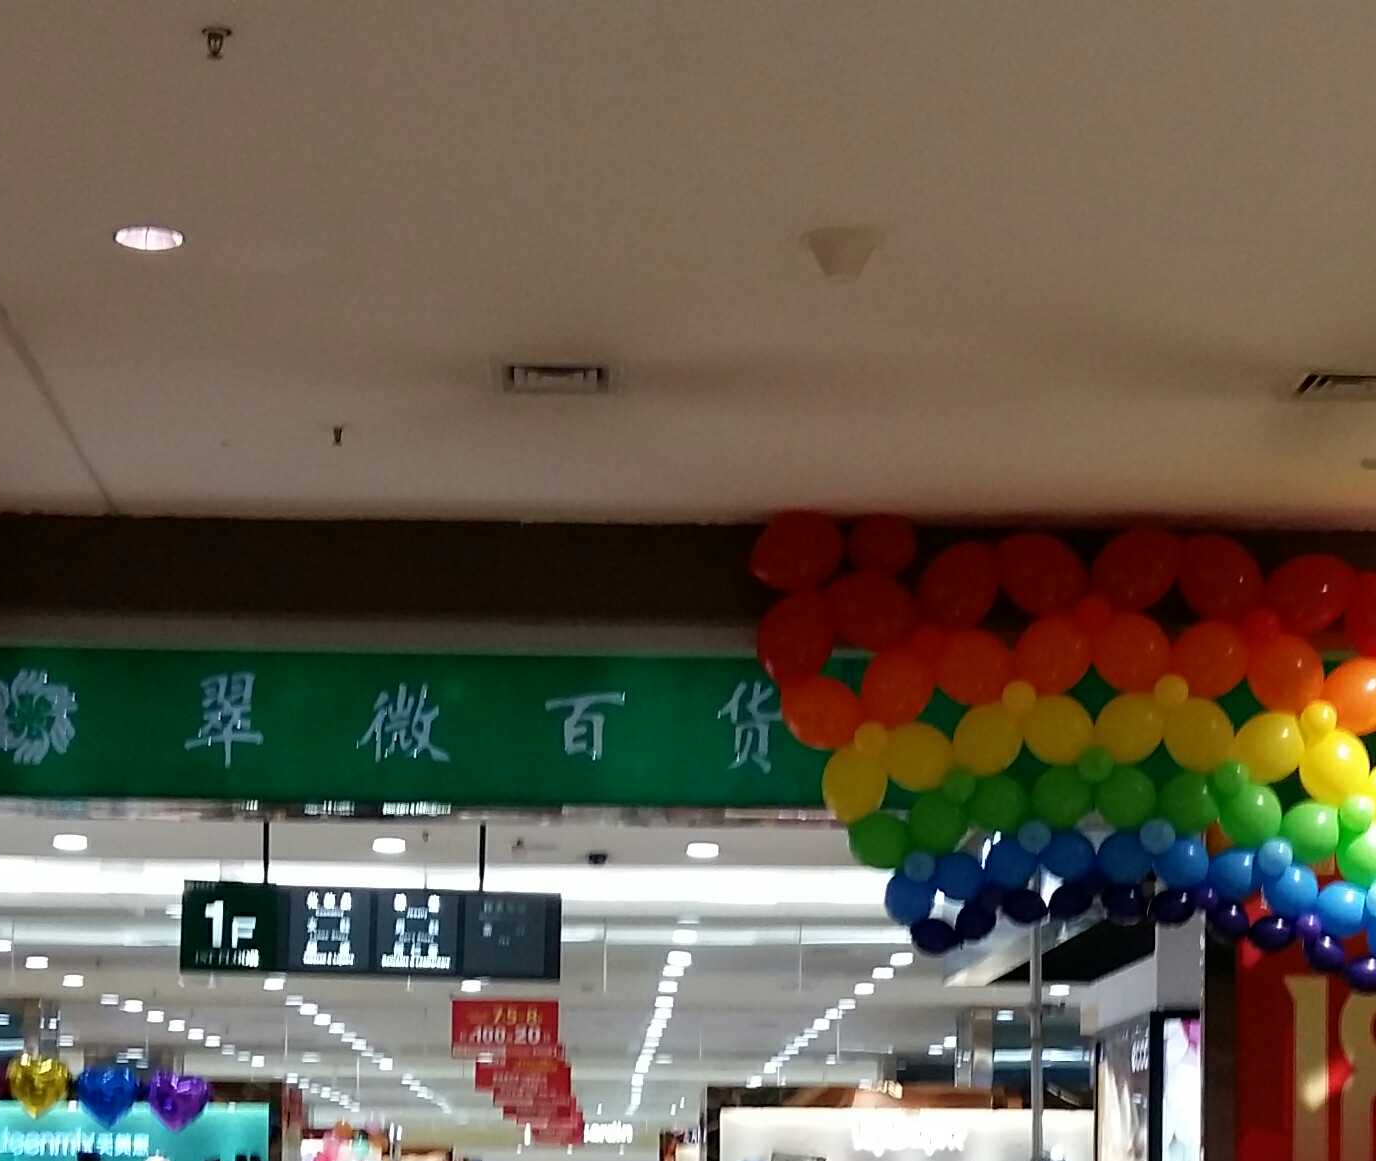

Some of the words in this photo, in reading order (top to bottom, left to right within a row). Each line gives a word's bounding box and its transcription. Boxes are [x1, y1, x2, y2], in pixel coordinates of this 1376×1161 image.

[183, 671, 782, 774] 翠微百货
[205, 899, 257, 949] 1F
